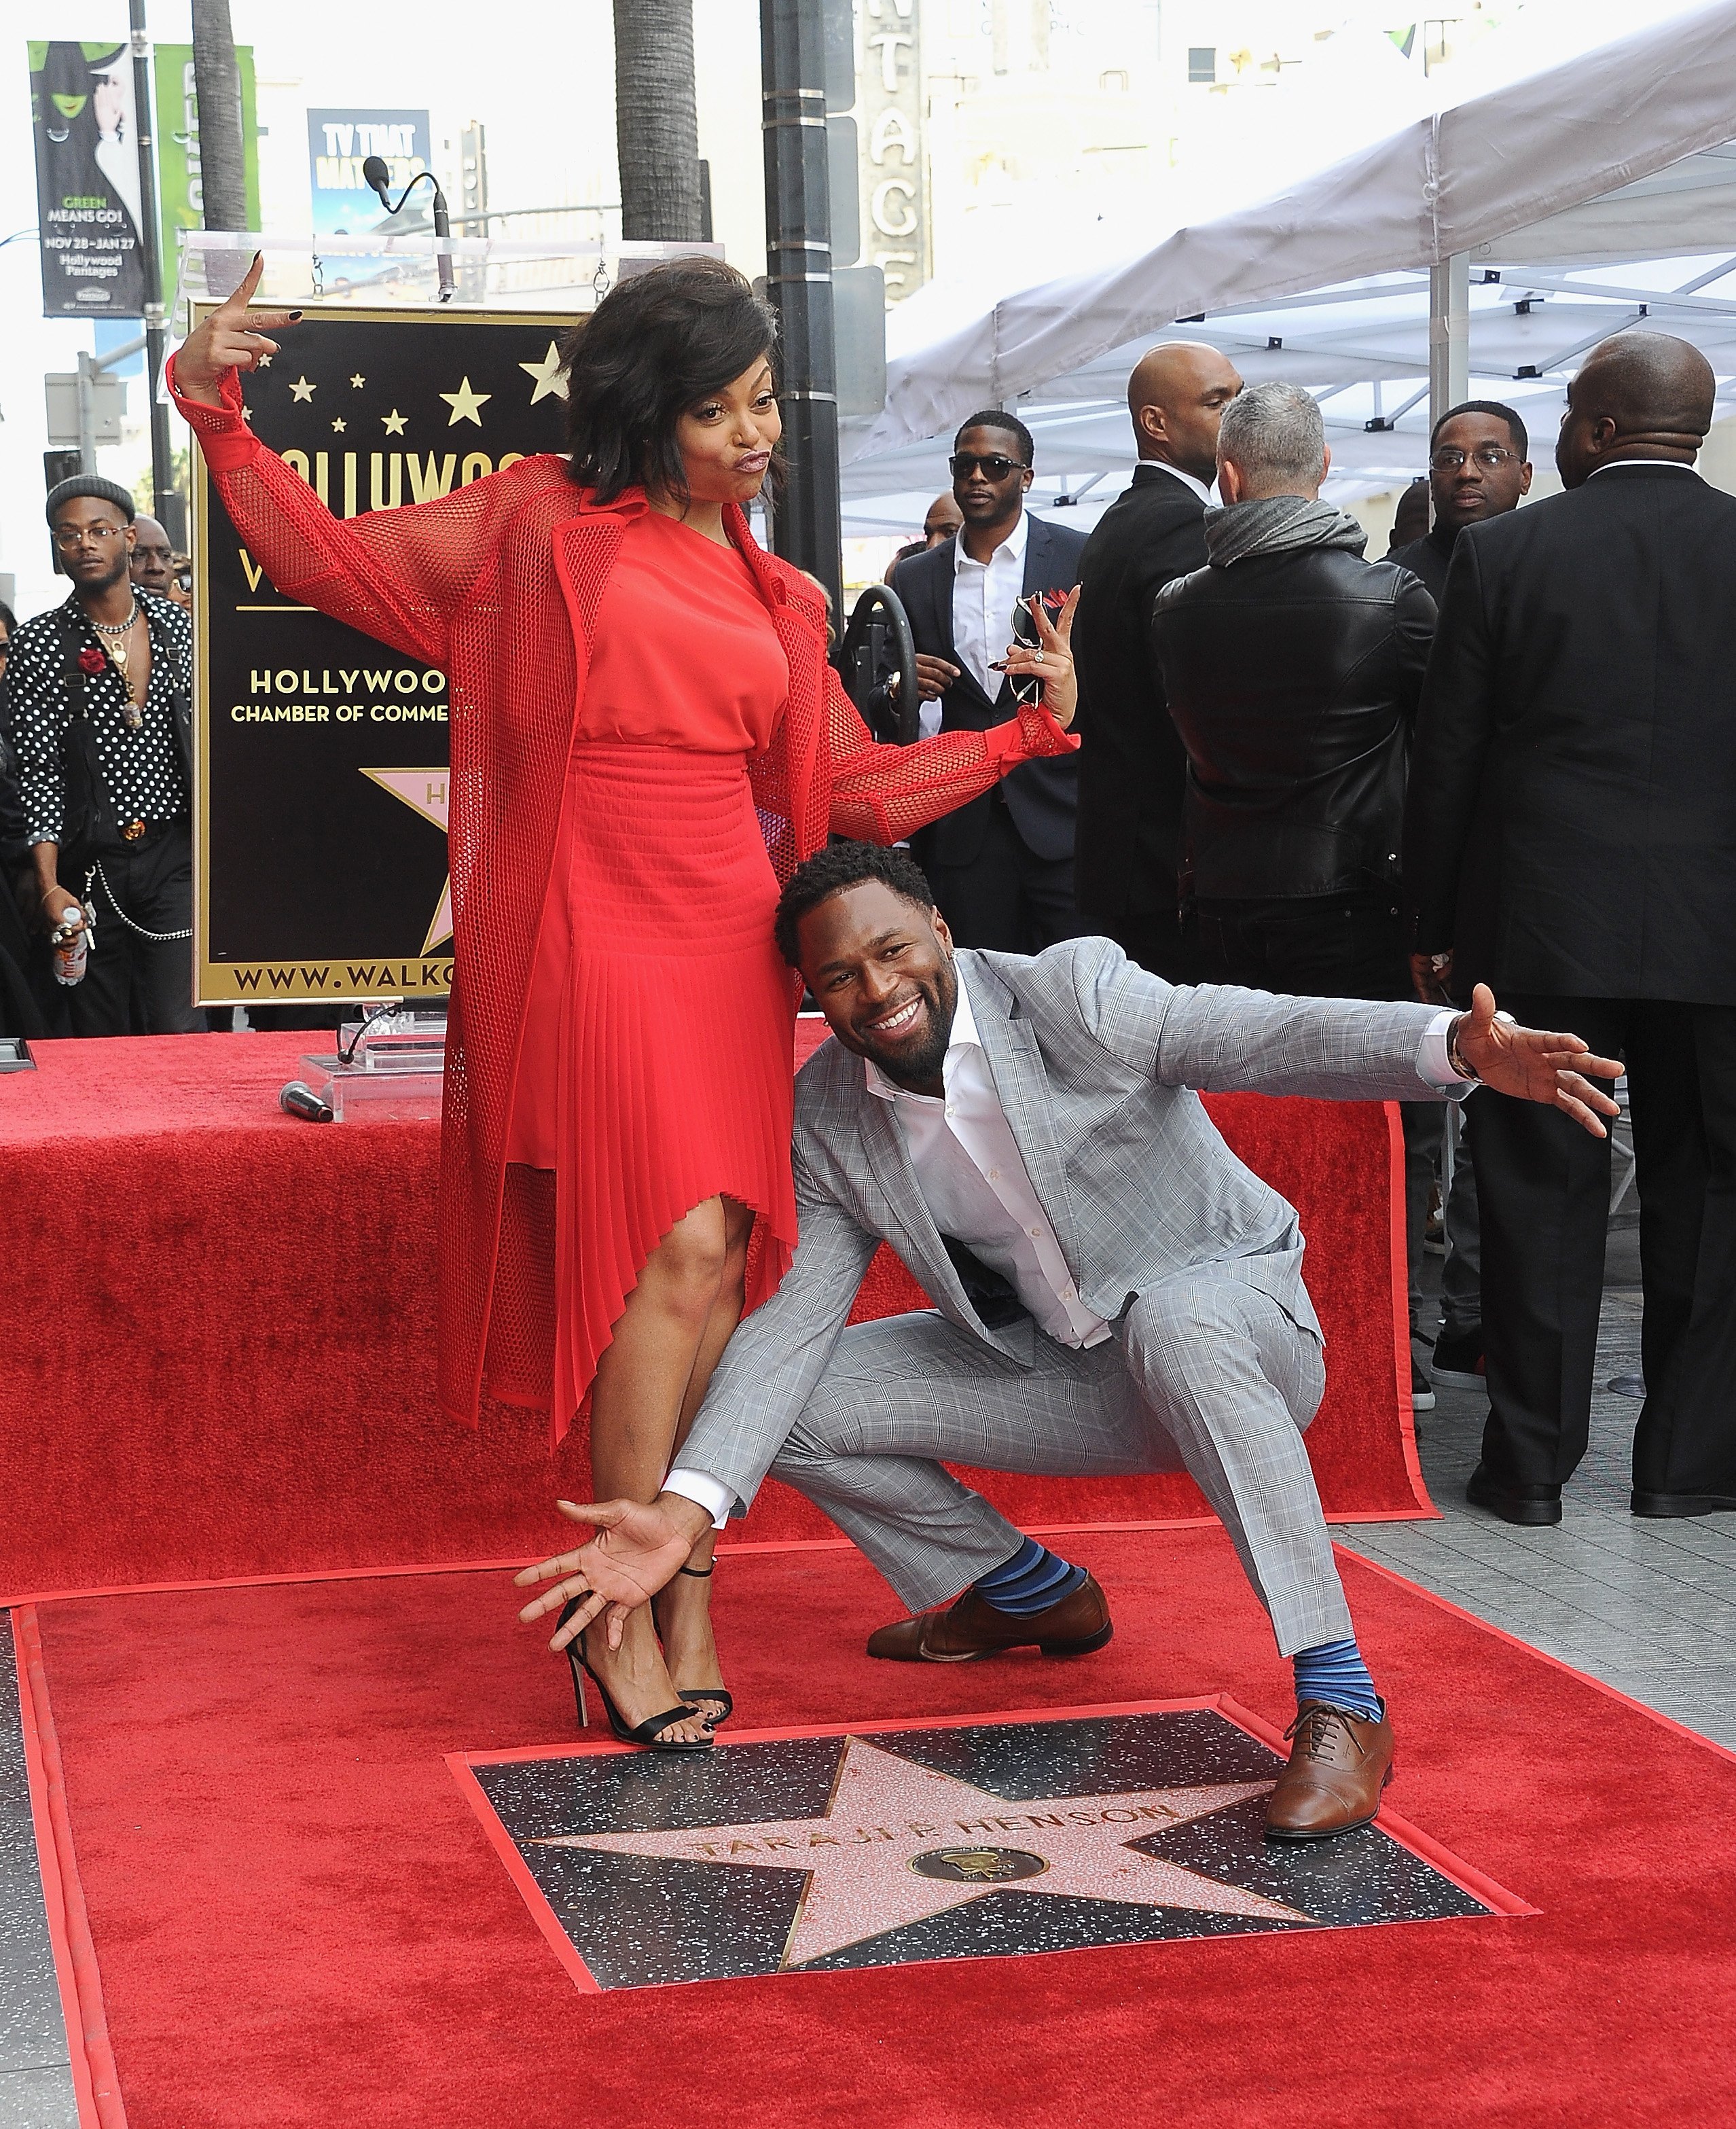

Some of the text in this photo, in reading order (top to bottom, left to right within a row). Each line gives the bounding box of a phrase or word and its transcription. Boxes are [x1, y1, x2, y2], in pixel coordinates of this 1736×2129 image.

[322, 123, 416, 158] TV THAT
[316, 156, 426, 190] MATERS
[62, 196, 107, 209] GREEN
[47, 209, 123, 223] MEANS GO!
[44, 237, 72, 249] NOV
[120, 238, 135, 249] 27
[59, 253, 123, 266] Hollywood
[65, 266, 118, 279] Pantages
[250, 669, 446, 694] HOLLYWOO
[230, 704, 449, 722] CHAMBER OF COMME
[686, 1826, 895, 1856] TARAJI
[955, 1804, 1180, 1835] HENSON
